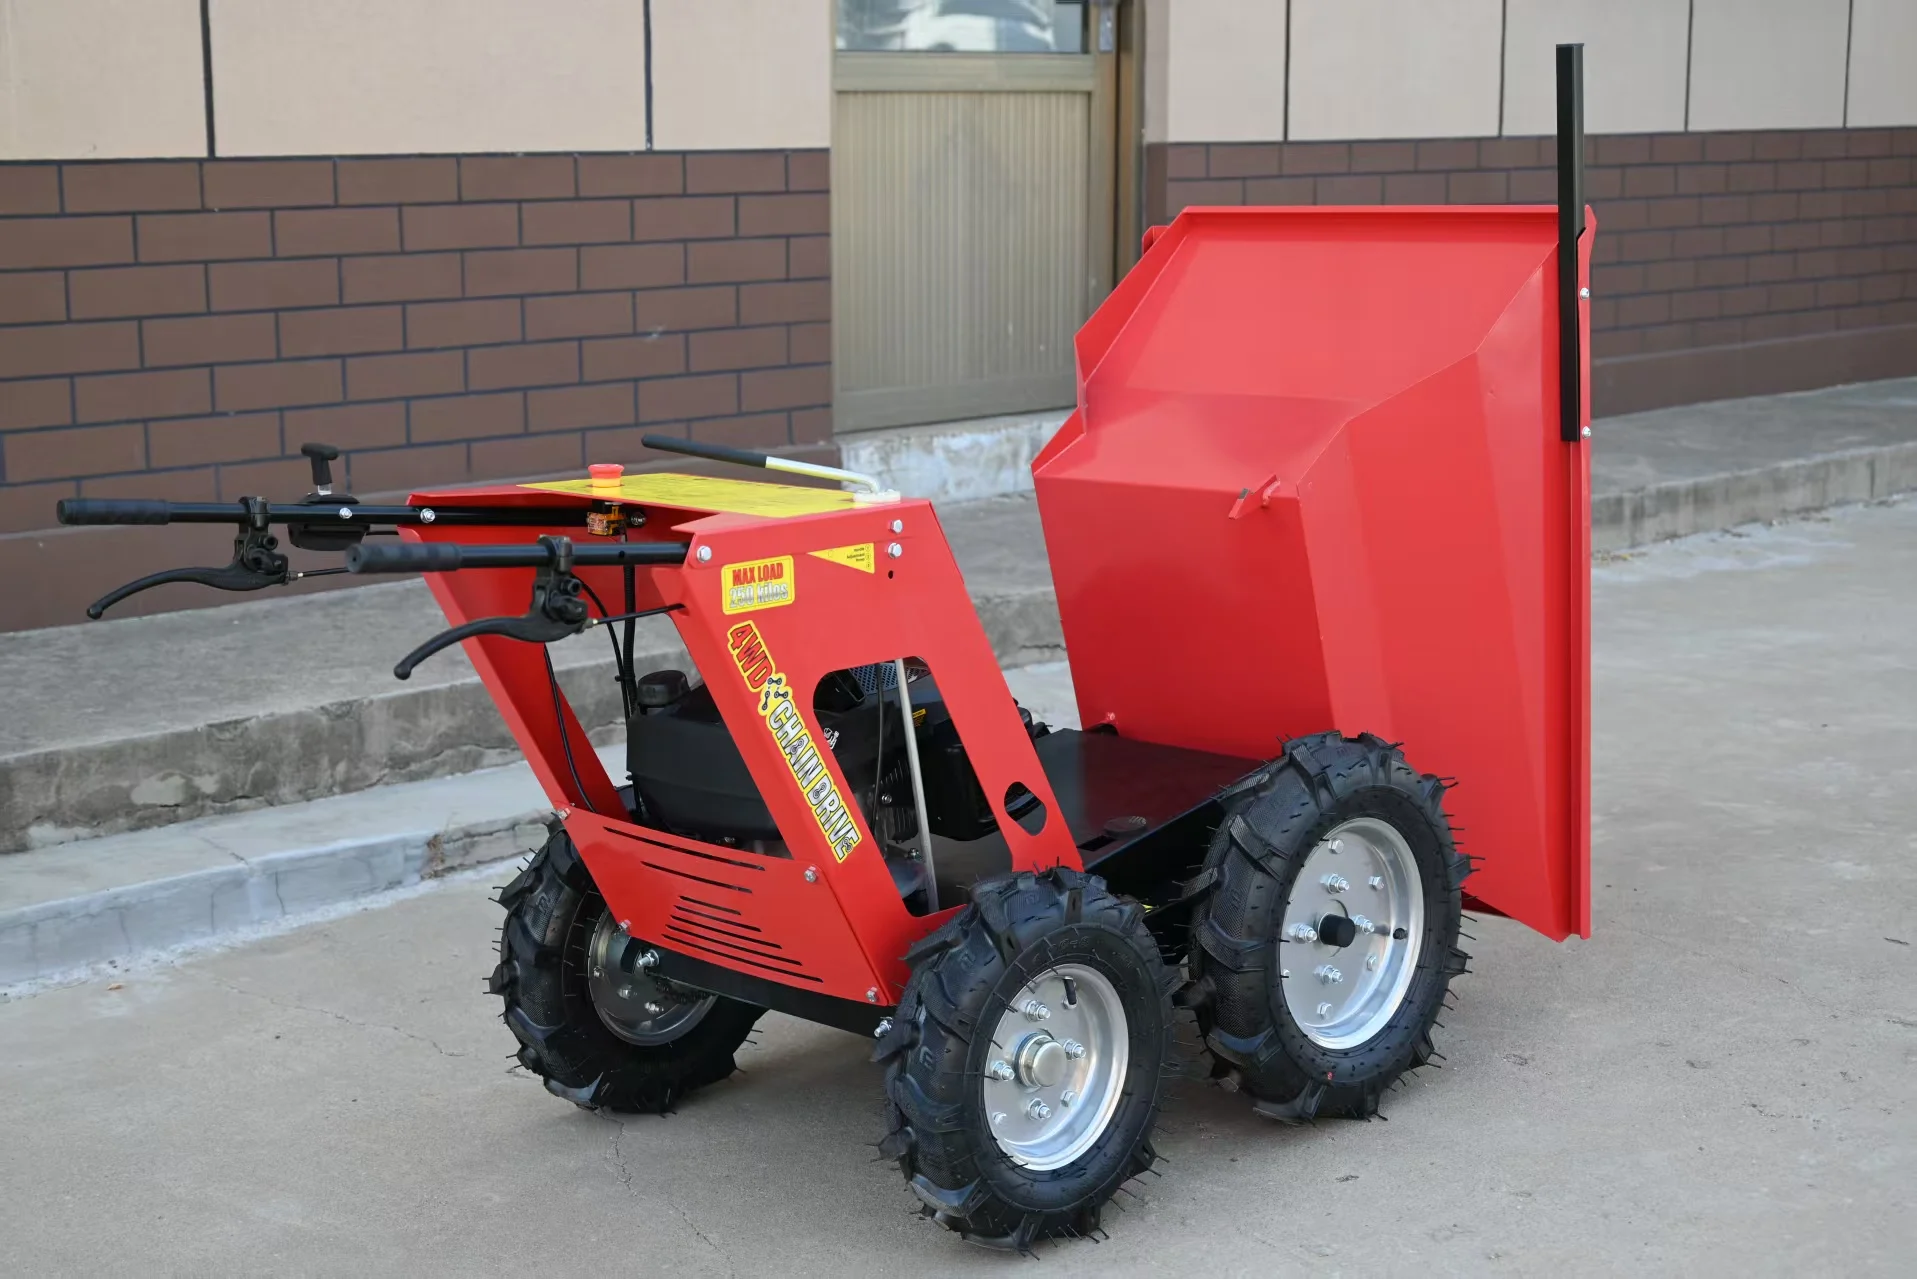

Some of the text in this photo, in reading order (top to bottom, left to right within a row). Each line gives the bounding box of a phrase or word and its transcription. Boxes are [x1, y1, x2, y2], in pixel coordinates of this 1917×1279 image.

[732, 562, 784, 587] MAX LOAD
[729, 582, 788, 608] 250 kilos
[730, 624, 860, 860] 4WD CHAIN DRIVE
